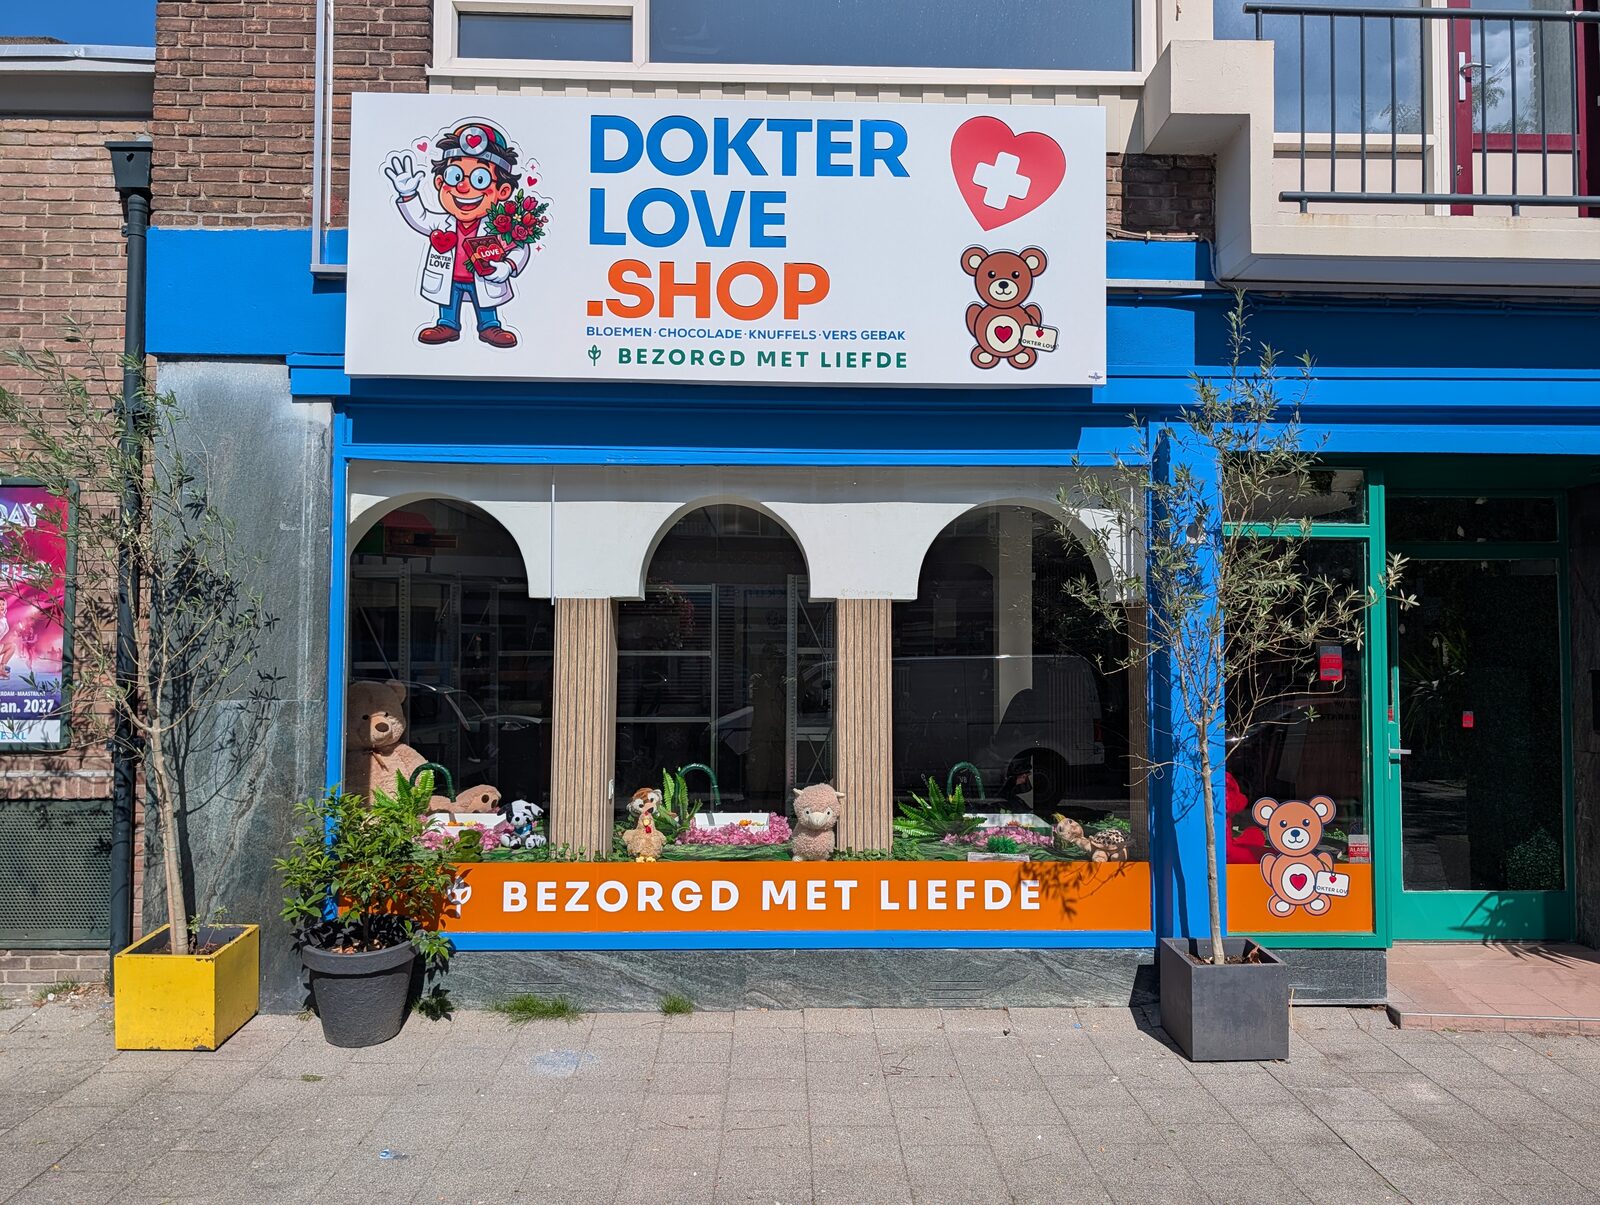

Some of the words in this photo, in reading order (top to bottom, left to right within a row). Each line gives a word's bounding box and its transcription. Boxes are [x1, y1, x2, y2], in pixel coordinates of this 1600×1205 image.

[590, 115, 911, 178] DOKTER
[589, 187, 787, 248] LOVE
[480, 248, 500, 258] LOVE
[429, 259, 451, 270] LOVE
[586, 258, 831, 321] .SHOP
[822, 329, 858, 341] VERS
[860, 329, 906, 342] GEBAK
[618, 348, 746, 367] BEZORGD
[757, 351, 809, 368] MET
[820, 352, 907, 369] LIEFDE
[23, 699, 54, 713] 2027
[502, 879, 740, 913] BEZORGD
[761, 879, 858, 911] MET
[880, 879, 1041, 911] LIEFDE
